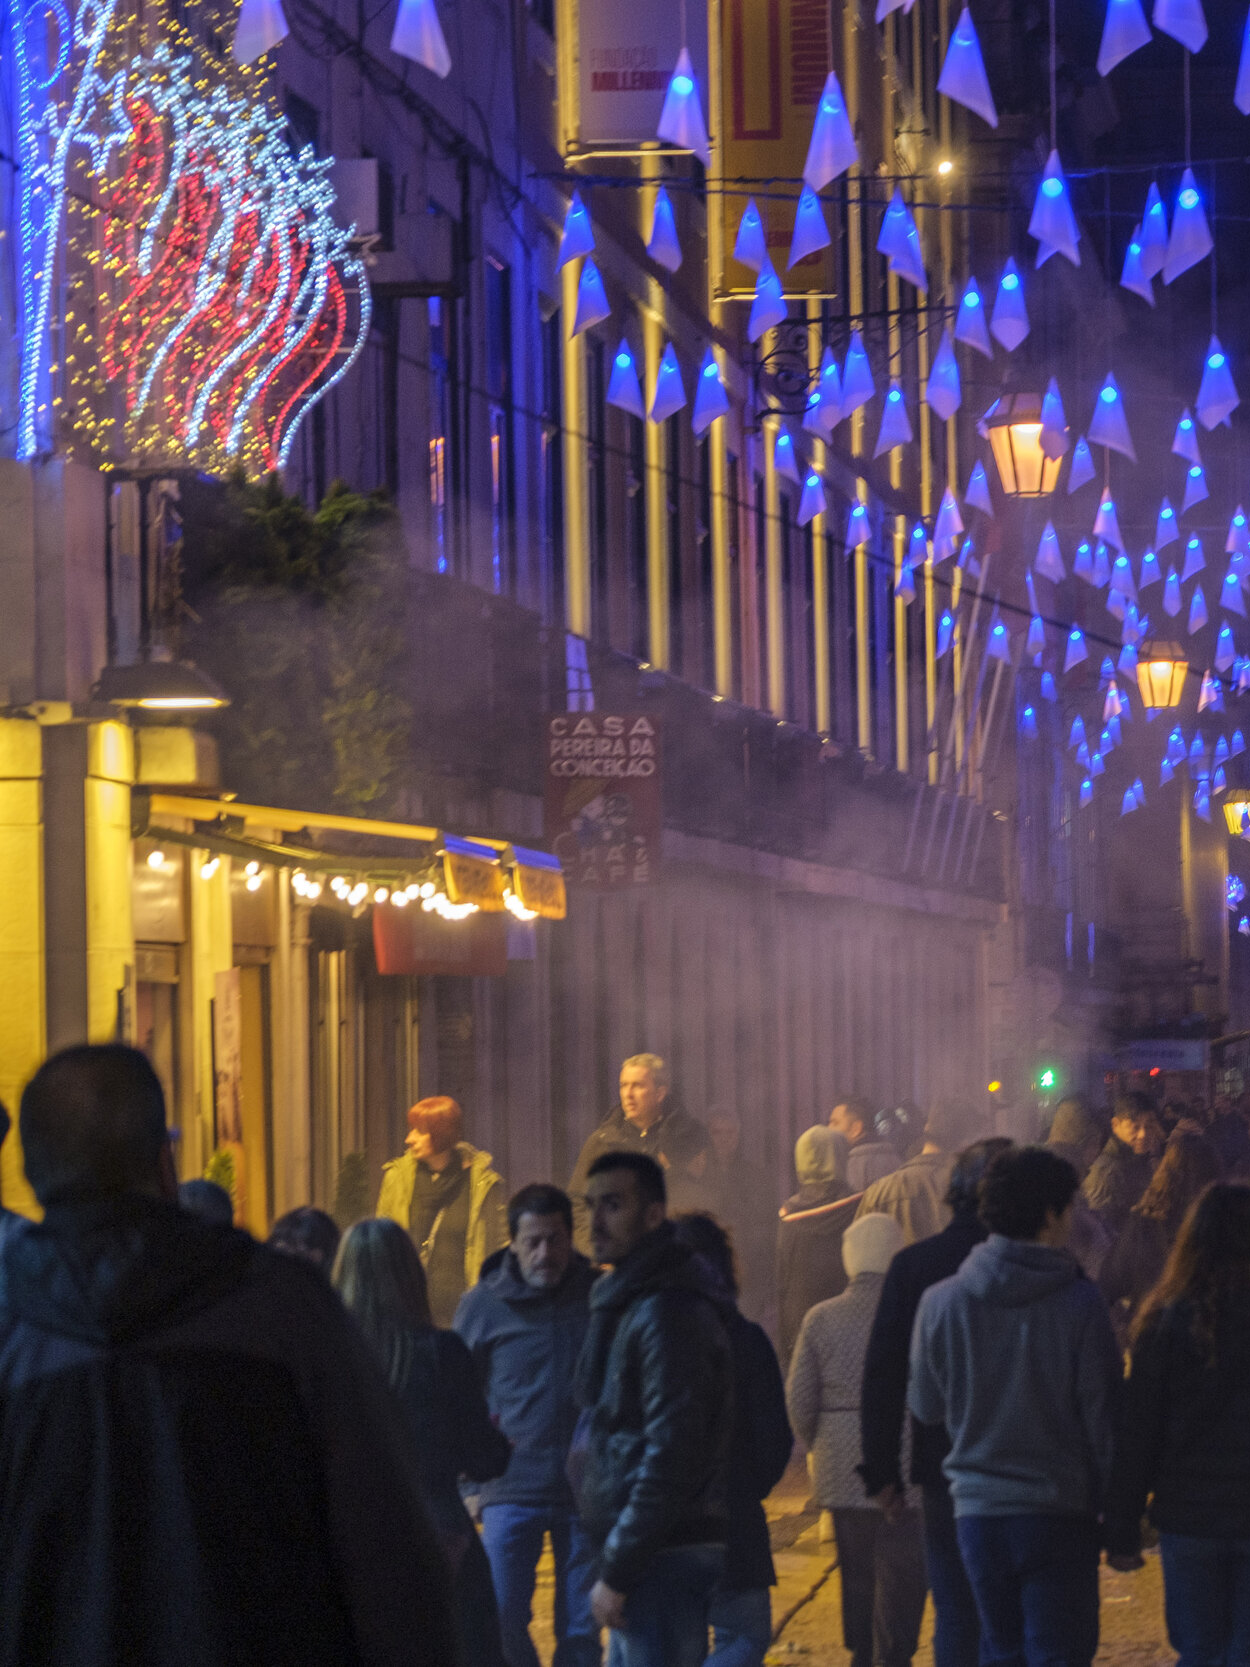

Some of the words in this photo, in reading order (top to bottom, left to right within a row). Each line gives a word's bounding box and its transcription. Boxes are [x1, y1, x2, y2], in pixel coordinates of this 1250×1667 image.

[550, 715, 655, 736] CASA
[550, 738, 626, 757] PEREIRA
[629, 738, 655, 757] DA
